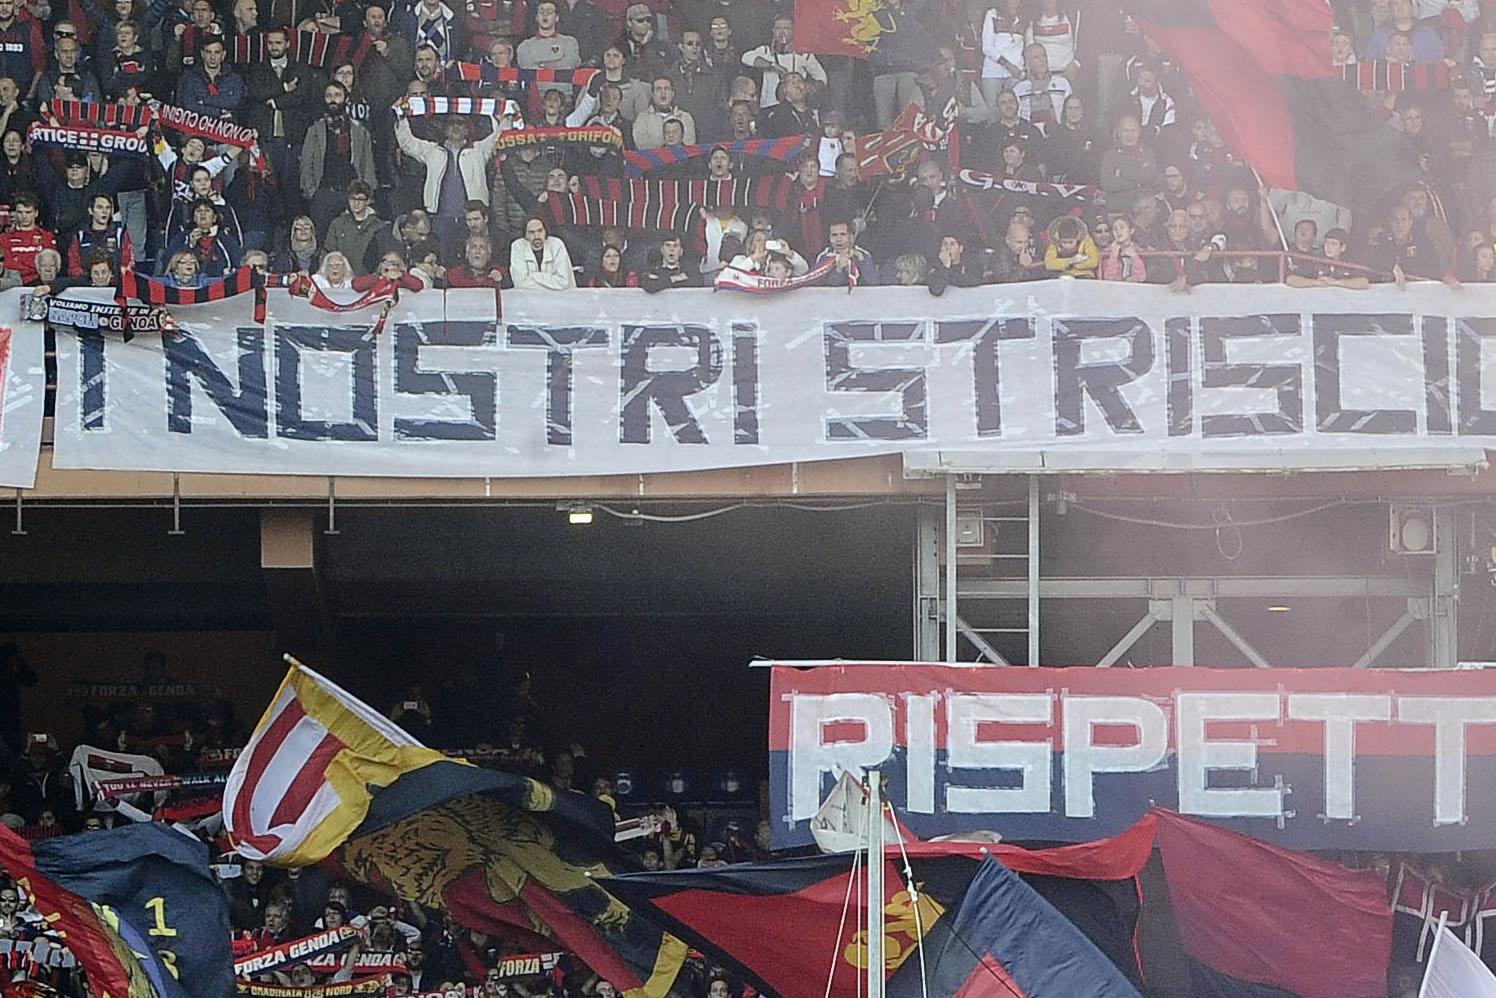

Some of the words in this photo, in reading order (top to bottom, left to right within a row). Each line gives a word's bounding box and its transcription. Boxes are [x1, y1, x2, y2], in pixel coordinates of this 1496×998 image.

[32, 126, 78, 143] RTICE
[101, 133, 150, 154] GROU
[49, 299, 88, 312] VOLIAMO
[48, 306, 99, 329] NAPOLI
[78, 330, 107, 434] I
[166, 319, 760, 446] NOSTRI
[233, 947, 286, 978] FORZA
[287, 931, 340, 960] GENOA
[497, 957, 541, 978] FORZA
[325, 984, 353, 998] NORD
